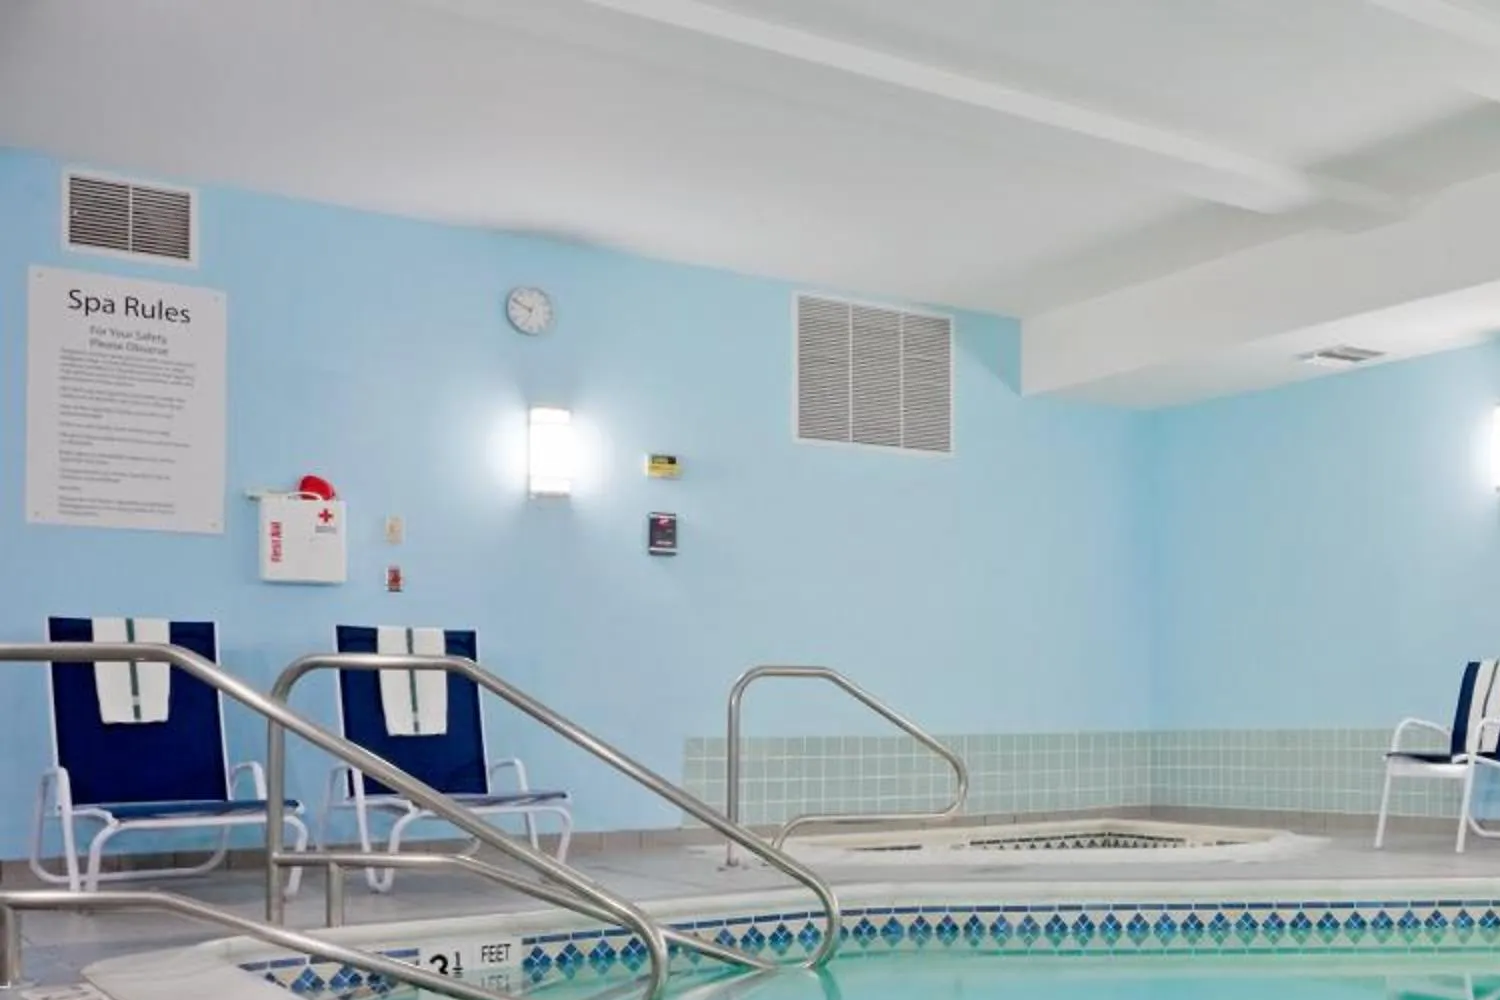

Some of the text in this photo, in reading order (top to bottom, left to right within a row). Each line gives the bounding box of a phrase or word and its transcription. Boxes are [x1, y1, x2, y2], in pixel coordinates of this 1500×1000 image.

[68, 289, 191, 323] Spa Rules
[89, 325, 107, 336] For
[109, 328, 133, 339] Your
[481, 943, 511, 962] FEET
